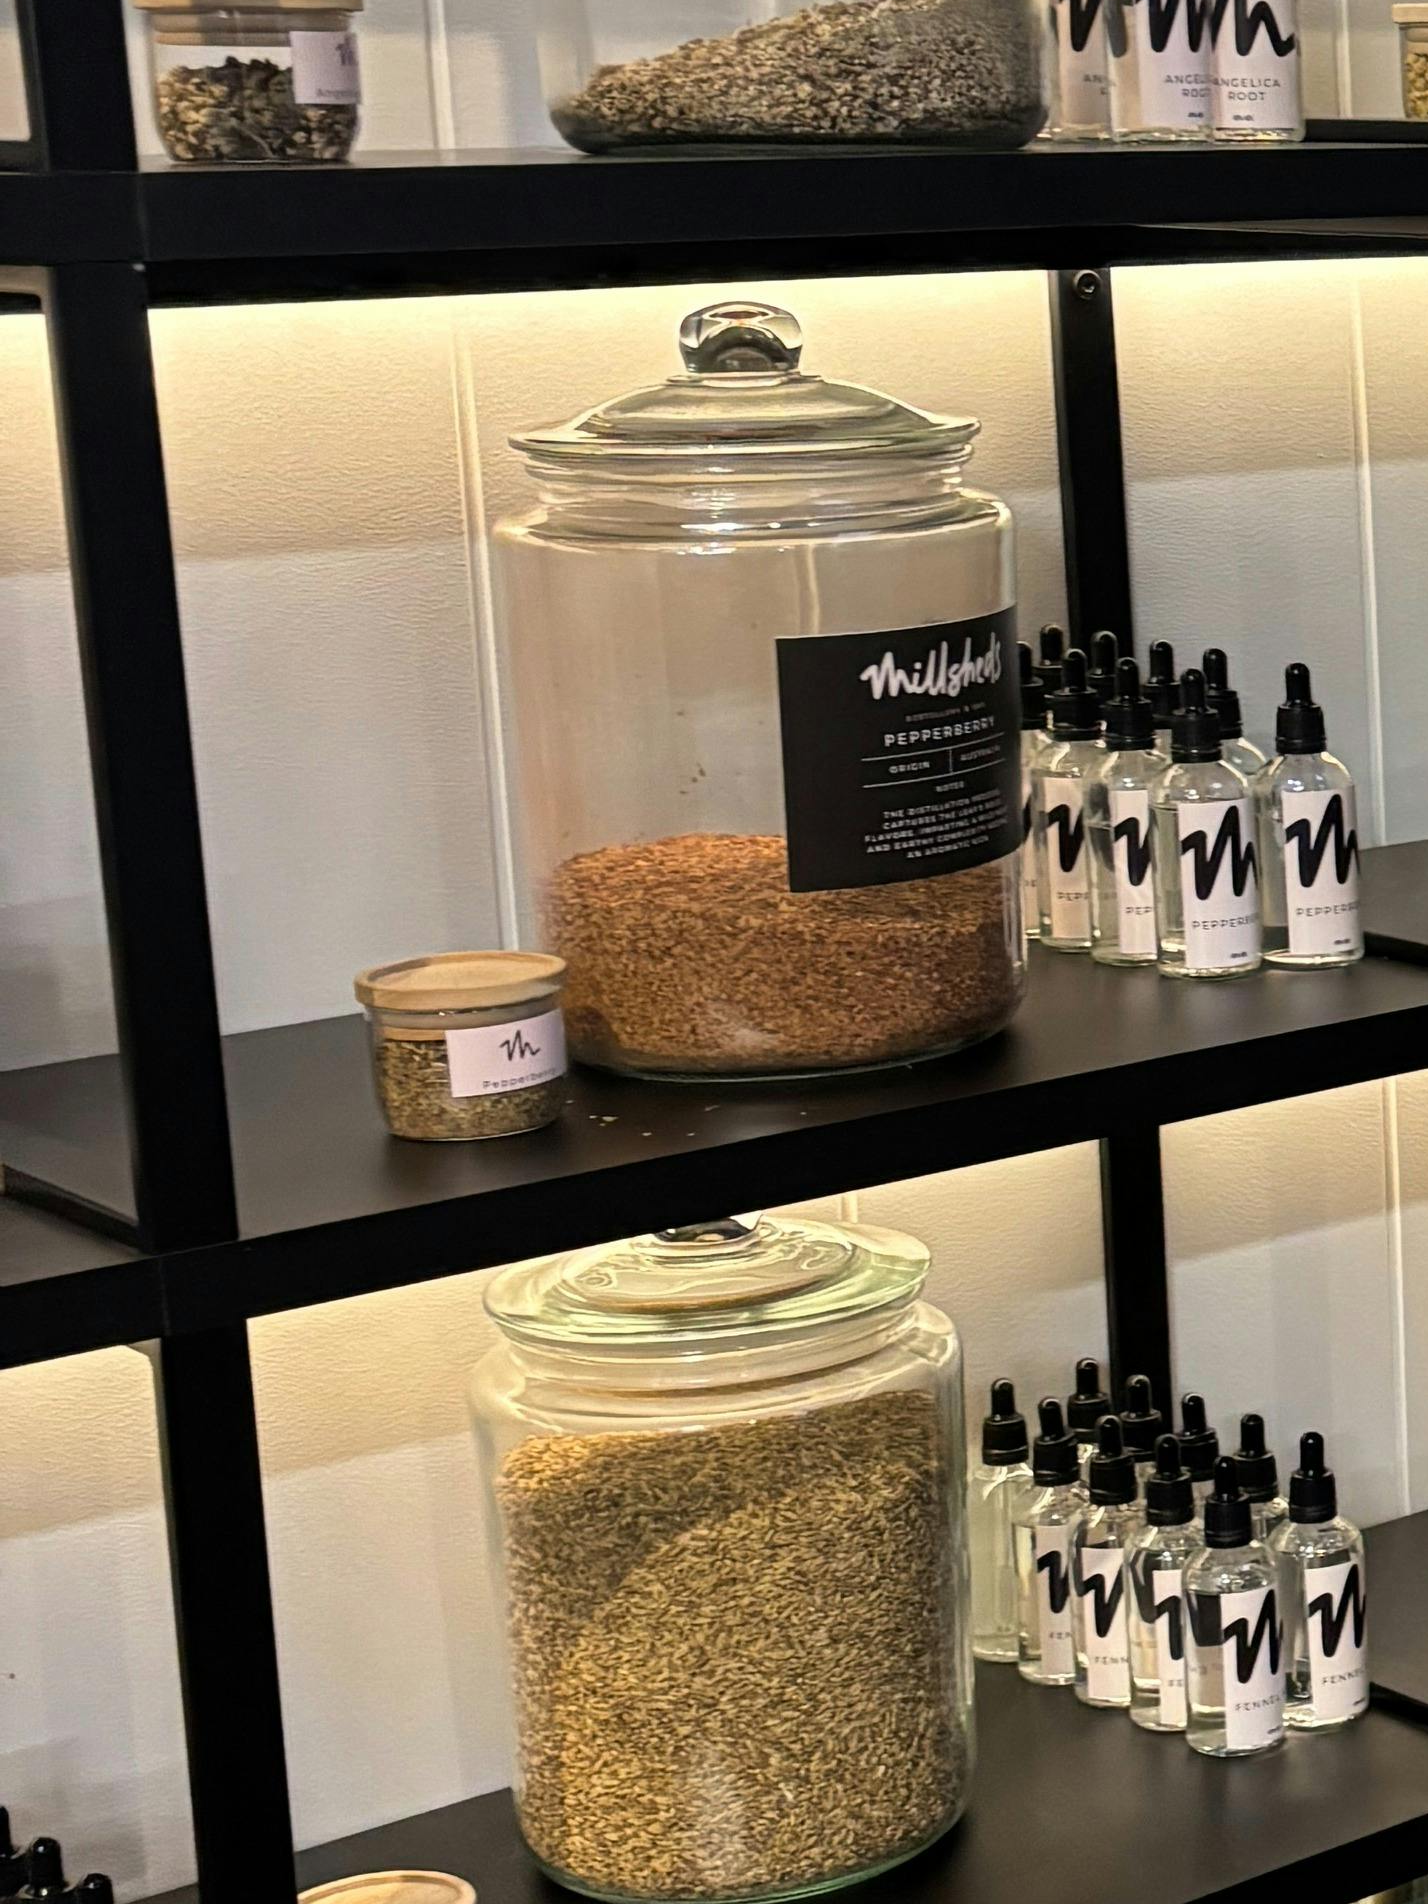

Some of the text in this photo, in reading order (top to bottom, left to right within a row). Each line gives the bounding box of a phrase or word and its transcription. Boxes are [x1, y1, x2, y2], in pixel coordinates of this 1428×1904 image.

[1227, 91, 1266, 101] ROOT
[884, 716, 995, 747] PEPPERBERRY
[888, 761, 930, 774] ORIGIN
